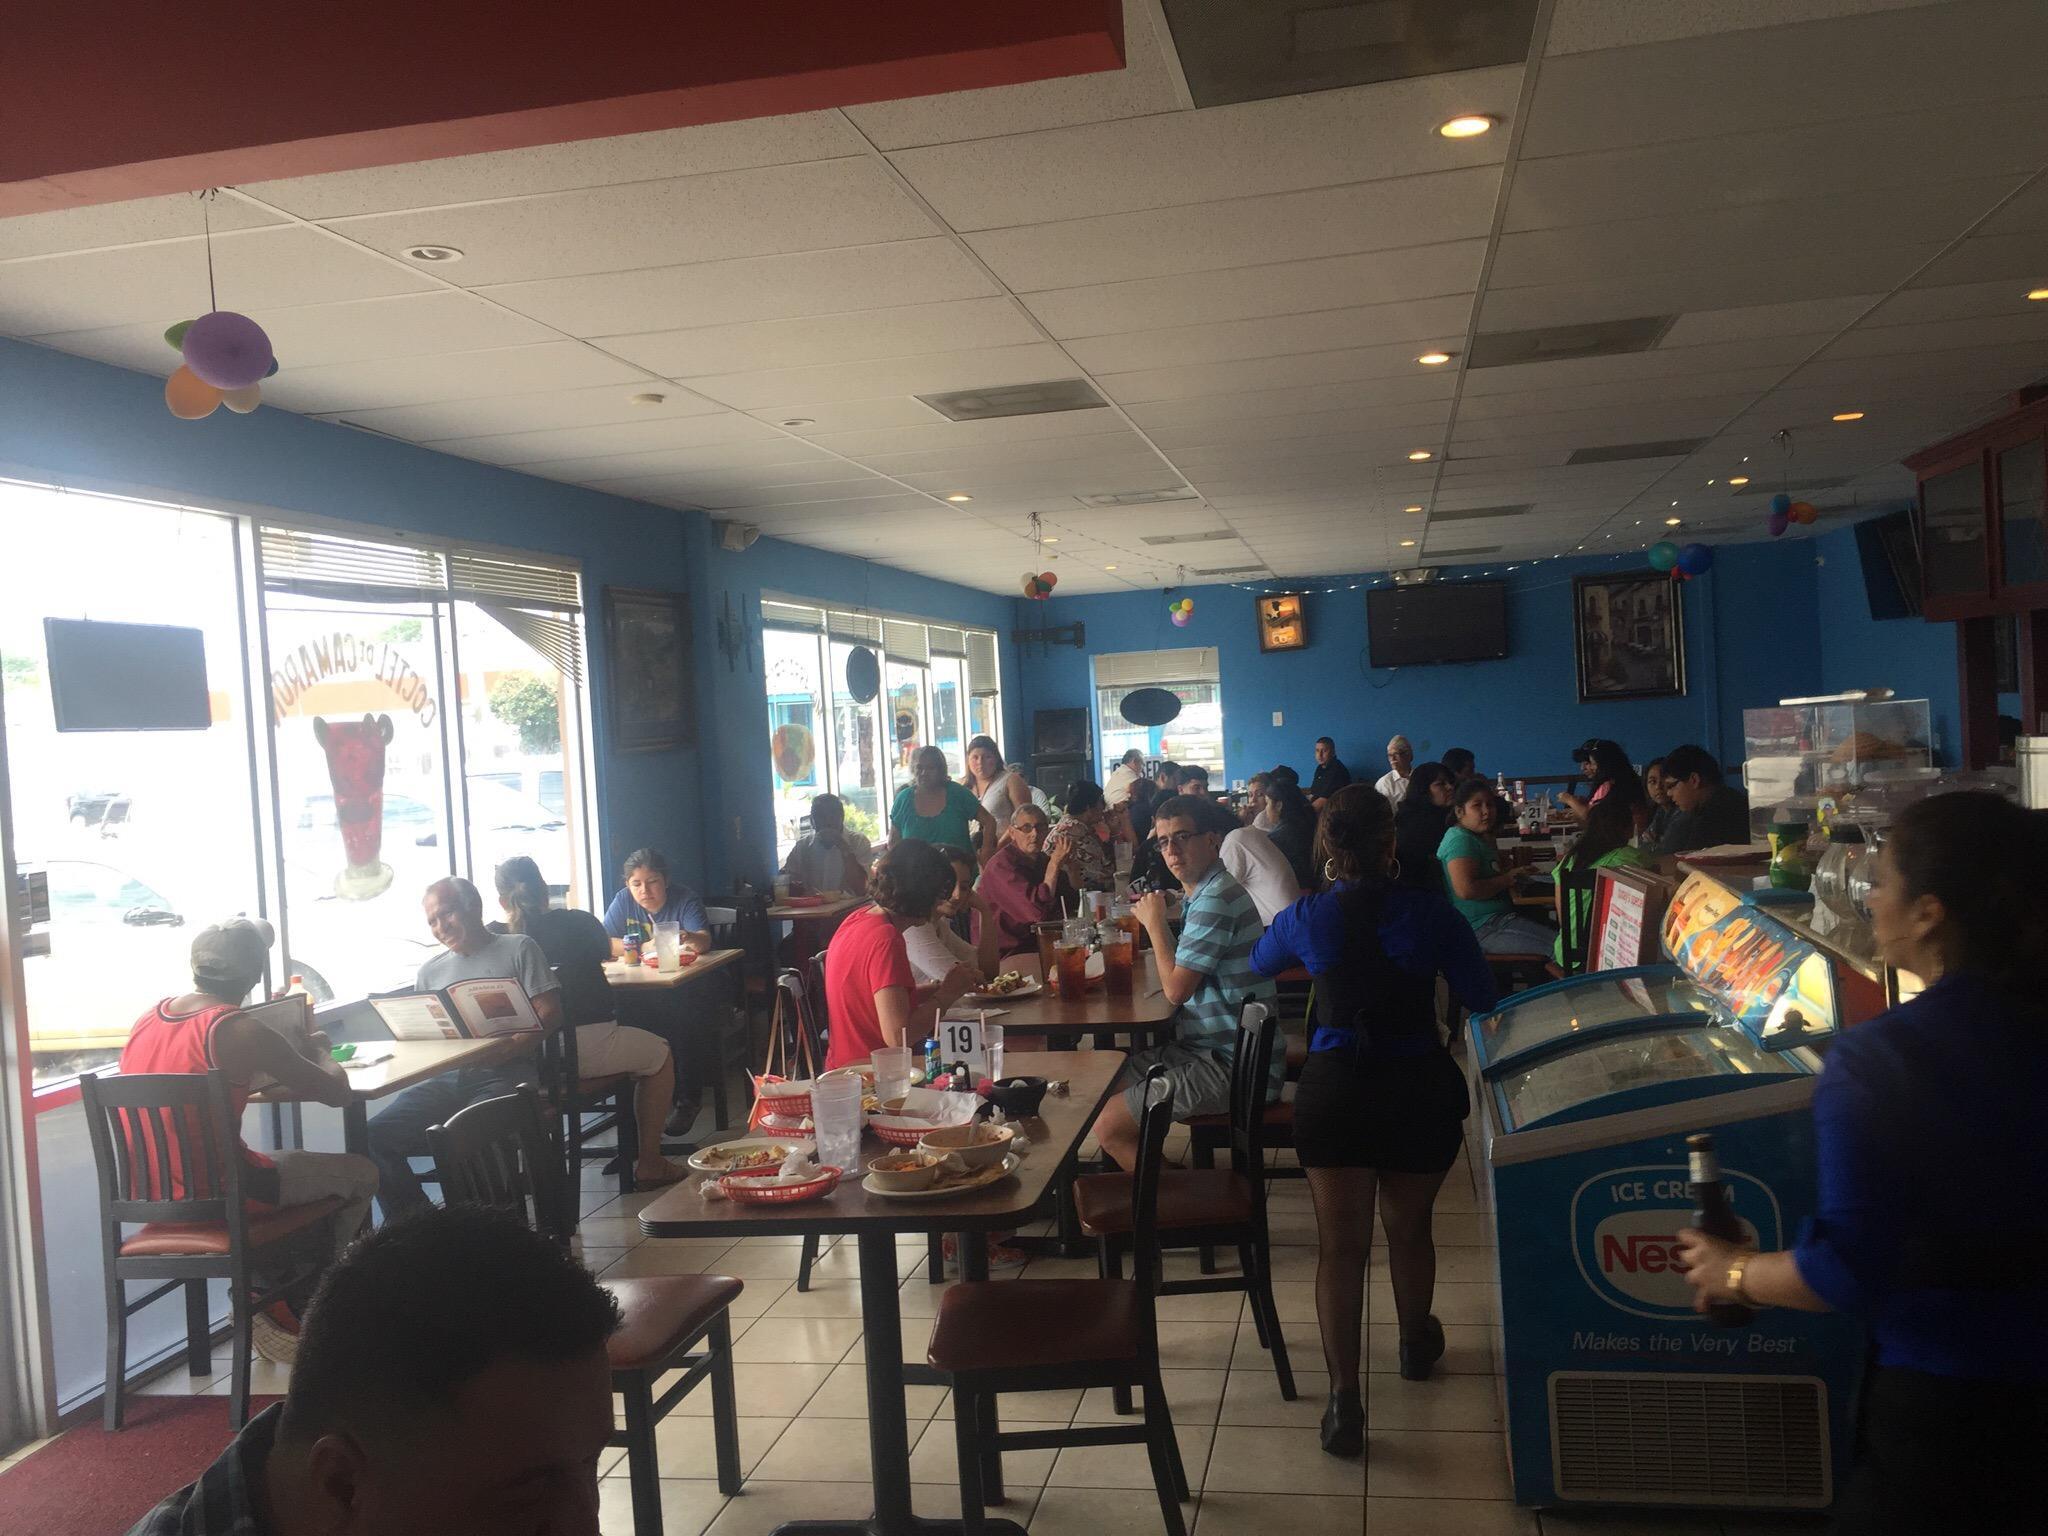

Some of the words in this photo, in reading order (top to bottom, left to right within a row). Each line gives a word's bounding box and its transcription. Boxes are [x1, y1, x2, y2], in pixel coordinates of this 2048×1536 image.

[1528, 807, 1541, 819] 21
[947, 1025, 973, 1054] 19
[1611, 1181, 1647, 1203] ICE
[1653, 1179, 1735, 1202] CREM
[1572, 1331, 1641, 1351] Makes
[1649, 1332, 1682, 1352] the
[1690, 1332, 1740, 1356] Very
[1747, 1334, 1797, 1354] Best
